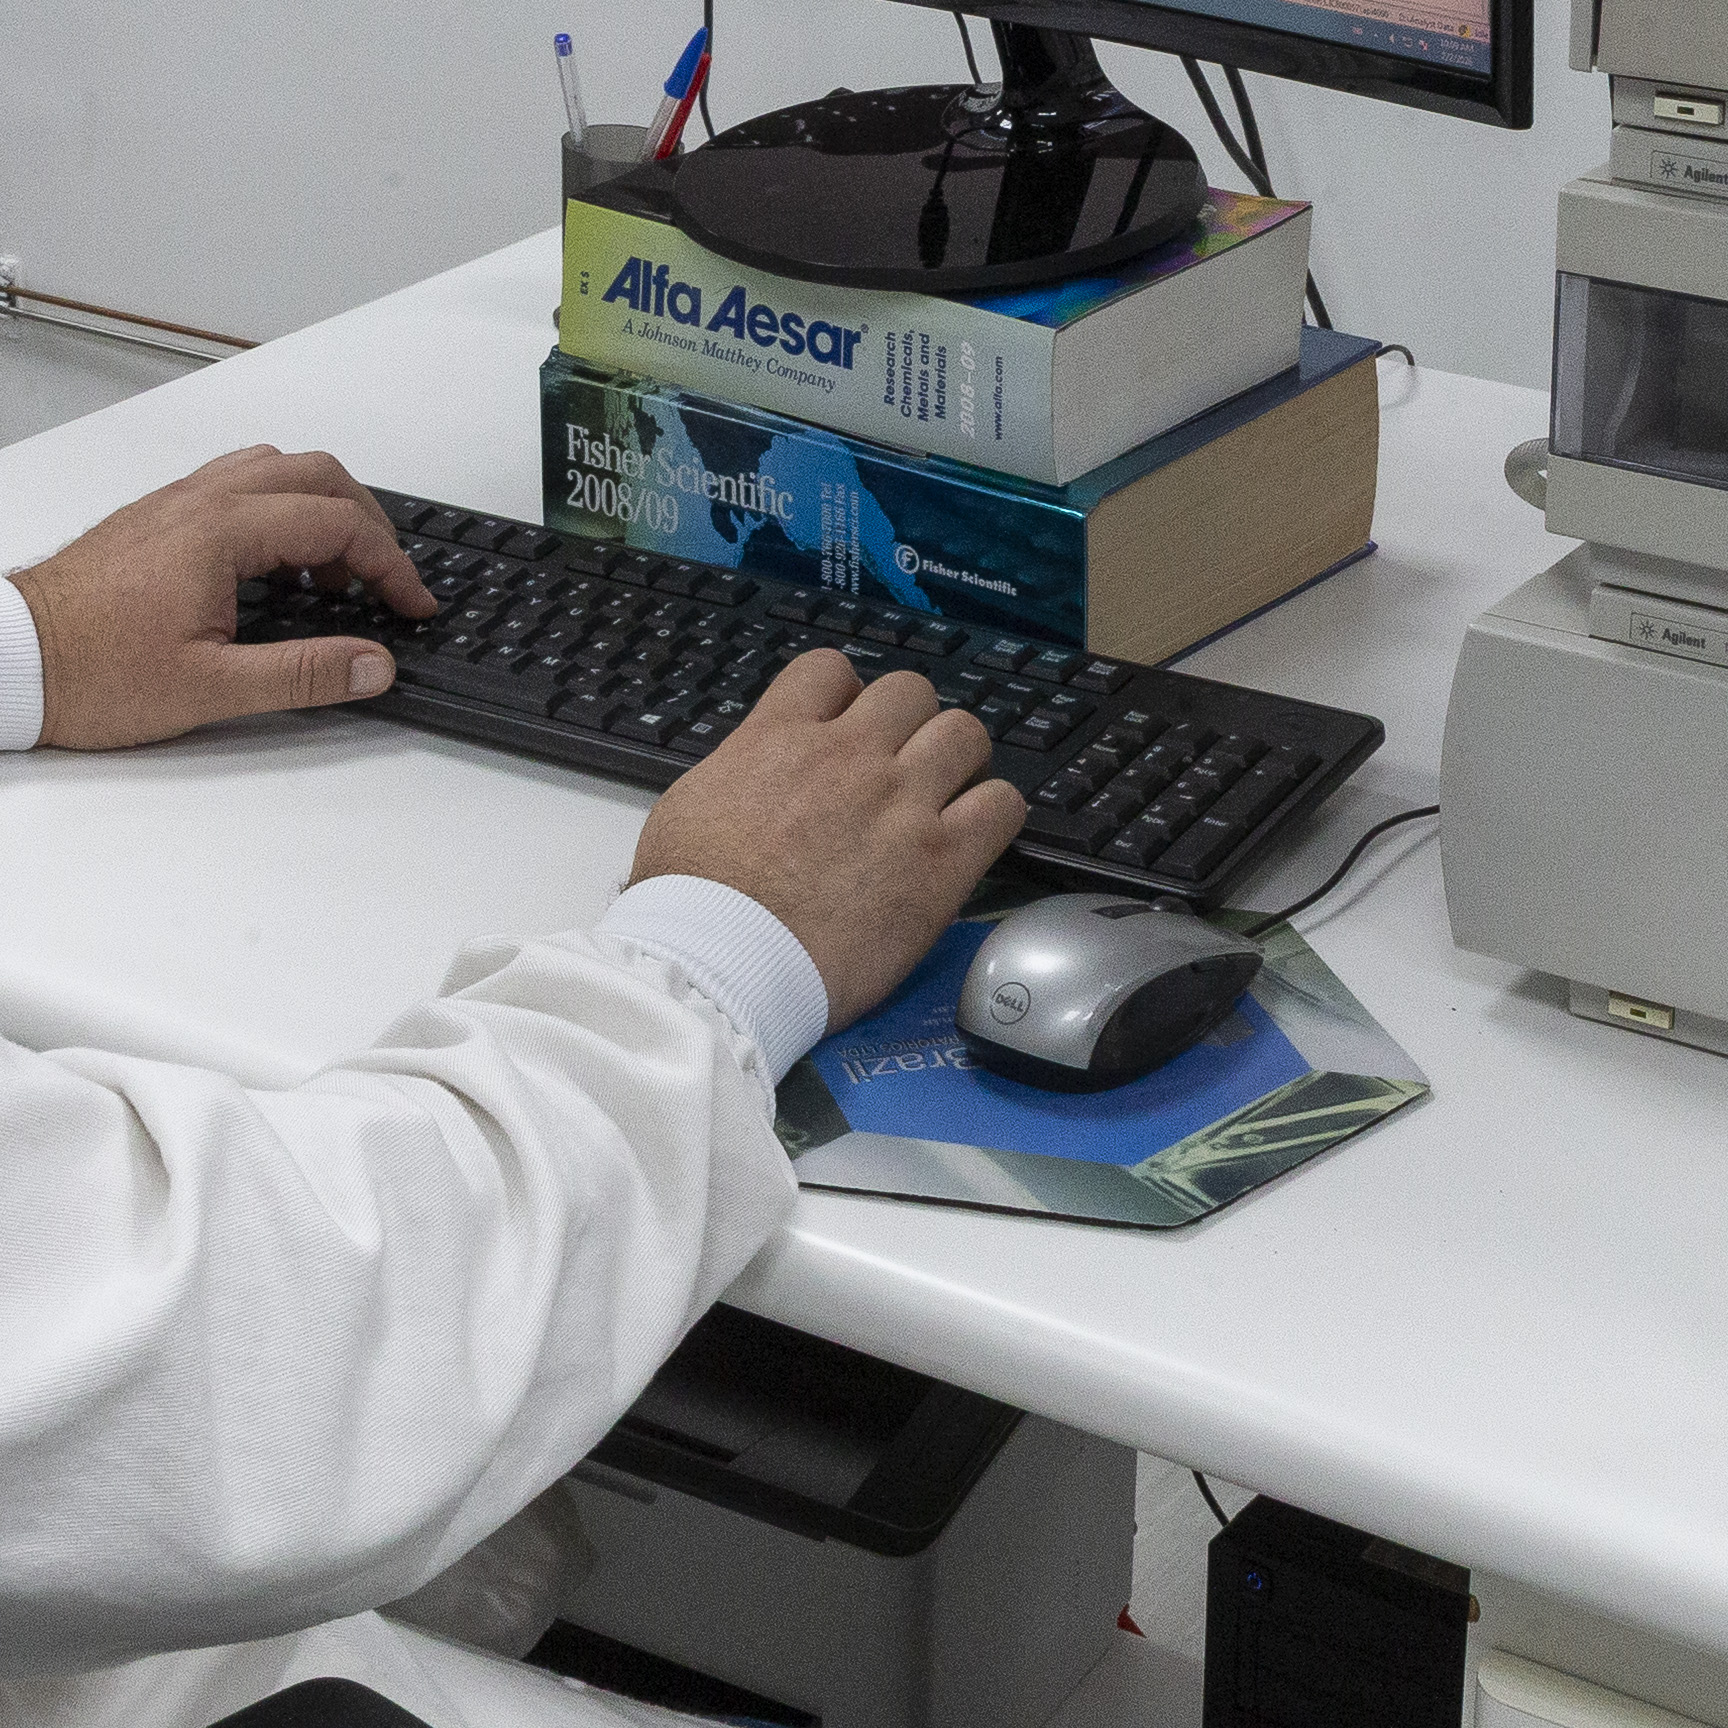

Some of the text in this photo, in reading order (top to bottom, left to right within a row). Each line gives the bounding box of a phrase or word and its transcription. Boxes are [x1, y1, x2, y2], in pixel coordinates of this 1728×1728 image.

[1684, 164, 1728, 186] Agilent
[601, 255, 862, 371] Alfa Aesar
[622, 318, 836, 393] A Johnson Matthey Company
[883, 332, 896, 406] Research
[900, 330, 914, 418] Chemicals,
[917, 333, 930, 422] Metals and
[934, 346, 947, 419] Materials
[565, 423, 794, 520] Fisher Scientific
[566, 469, 679, 534] 2008/09
[820, 481, 833, 499] Tel
[834, 483, 846, 590] -800-926-1166 Fax
[922, 559, 959, 581] Fisher
[961, 570, 1018, 597] Scientific
[1662, 627, 1706, 650] Agilent
[995, 993, 1024, 1013] DELL
[842, 1047, 974, 1085] Brazil
